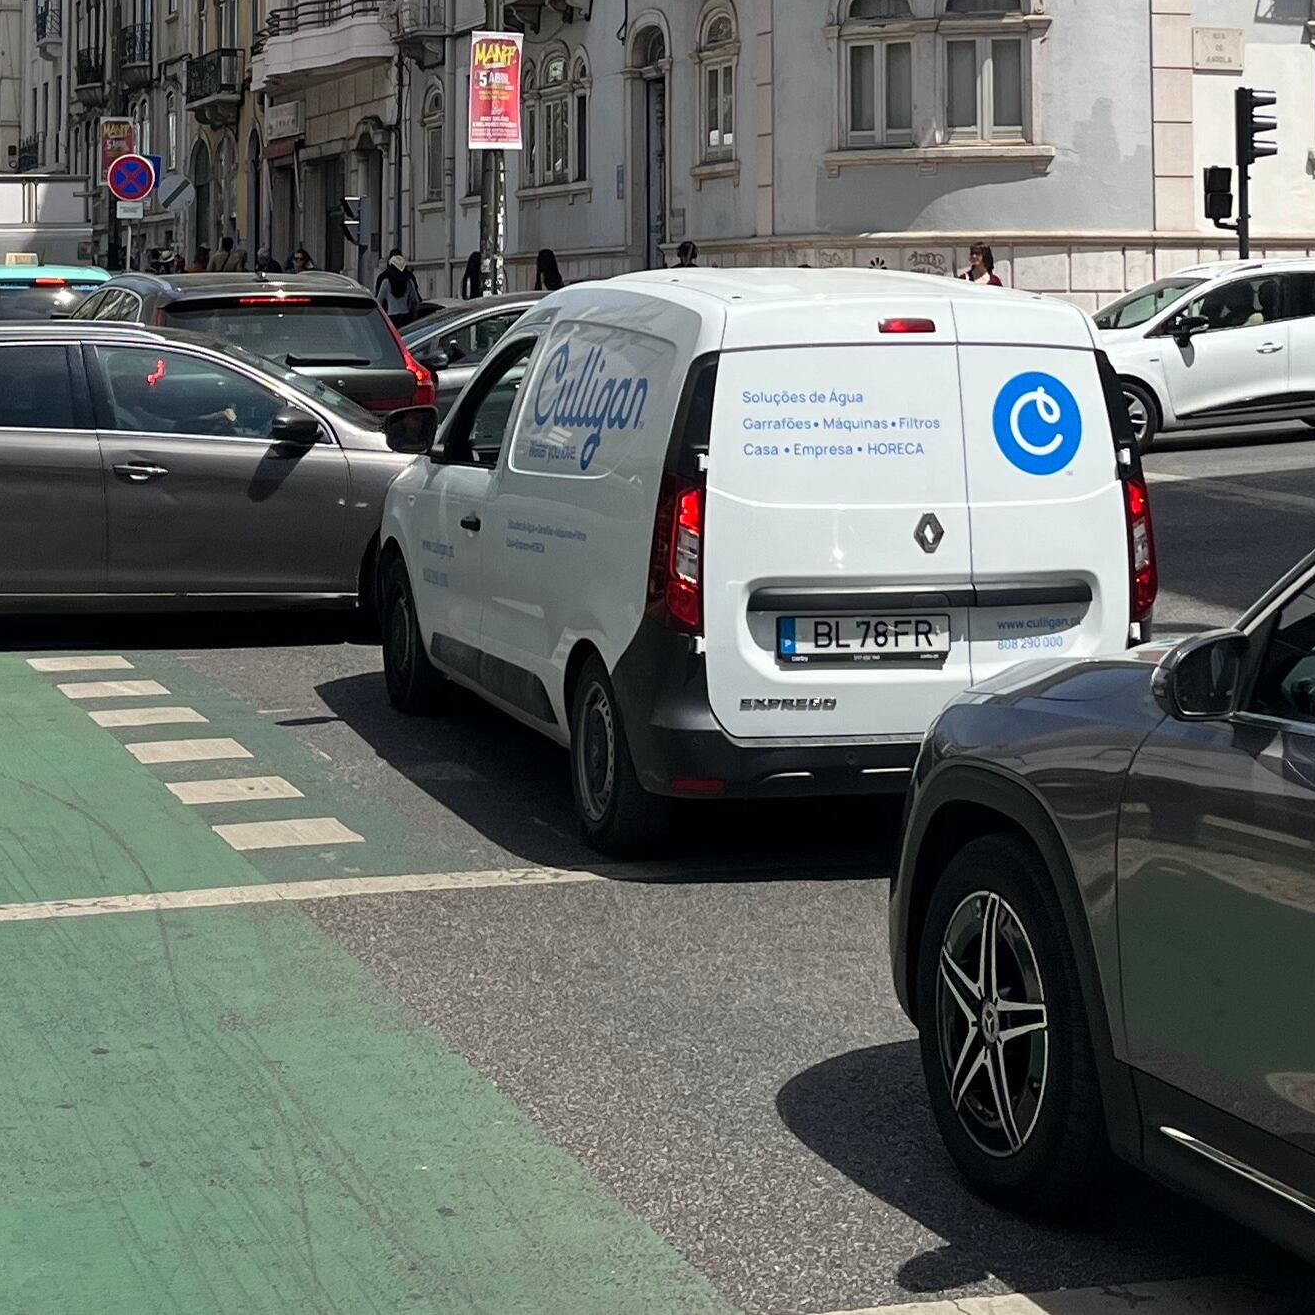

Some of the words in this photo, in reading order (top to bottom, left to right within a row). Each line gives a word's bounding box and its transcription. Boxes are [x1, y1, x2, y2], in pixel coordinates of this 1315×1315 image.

[479, 71, 487, 87] 5
[535, 339, 648, 470] Culligan
[742, 390, 806, 407] Soluções
[809, 391, 826, 403] de
[829, 388, 864, 407] Água
[742, 417, 811, 430] Garrafões
[823, 417, 888, 432] Máquinas
[899, 417, 941, 429] Filtros
[743, 443, 779, 456] Casa
[794, 443, 853, 458] Empresa
[867, 442, 924, 455] HORECA
[814, 621, 851, 648] BL
[856, 620, 888, 648] 78
[894, 620, 933, 648] FR
[997, 639, 1018, 650] 808
[1021, 637, 1041, 649] 290
[1043, 636, 1063, 648] 000
